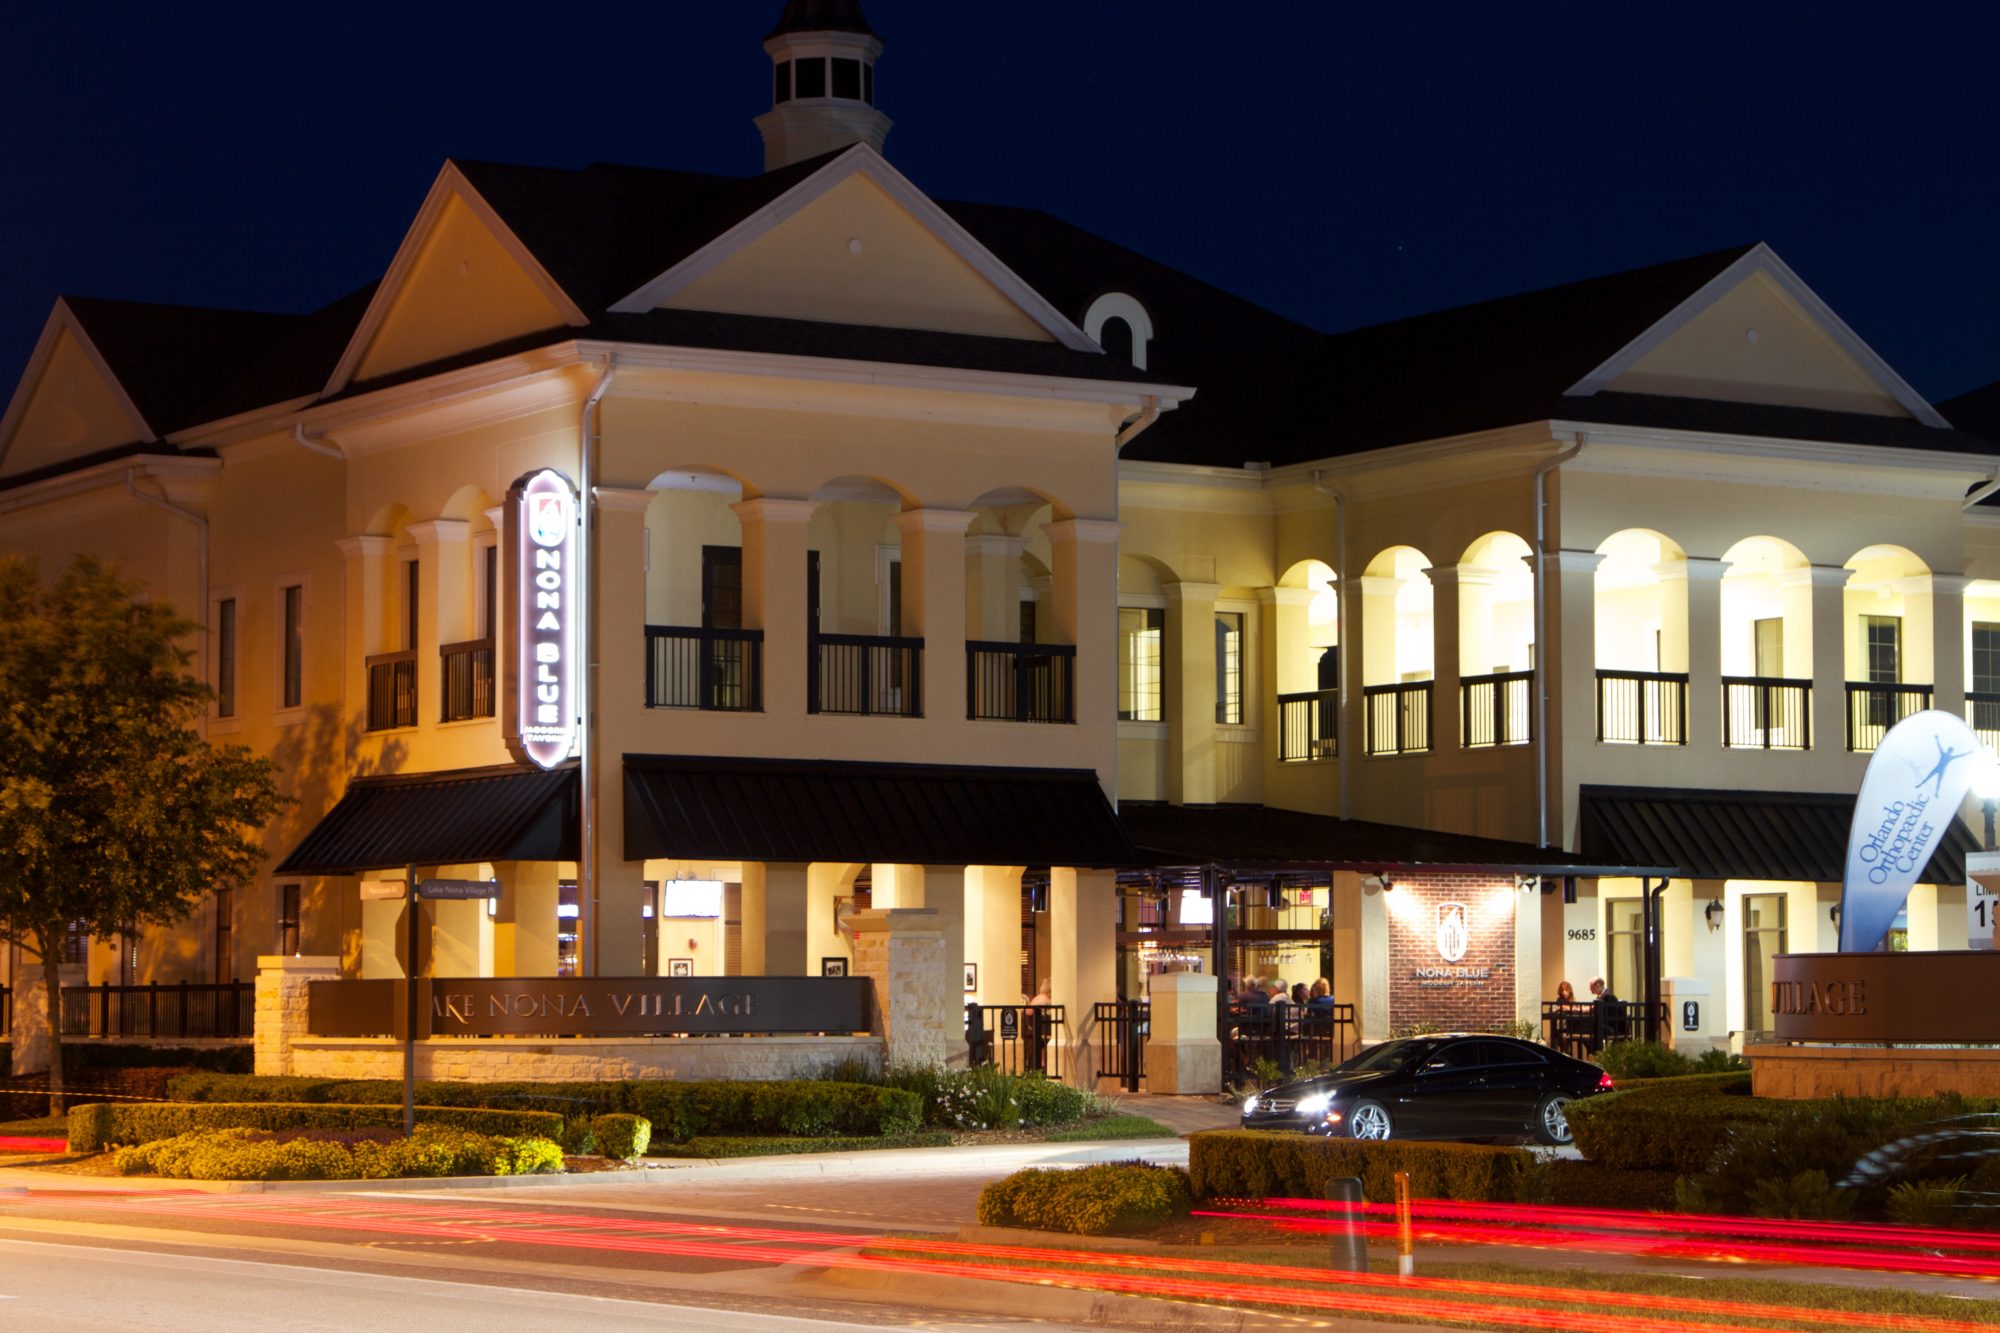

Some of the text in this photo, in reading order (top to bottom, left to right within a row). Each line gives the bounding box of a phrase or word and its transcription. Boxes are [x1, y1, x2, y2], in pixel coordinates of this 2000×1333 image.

[536, 549, 561, 723] NONA BLUE
[1860, 801, 1905, 863] Orlando
[1895, 821, 1935, 873] Center
[428, 884, 443, 893] Lake
[445, 884, 463, 893] Nona
[464, 885, 486, 895] Village
[1567, 929, 1596, 941] 9685
[1416, 967, 1489, 978] NONA BLUE
[432, 993, 759, 1024] AKE NONA VILLAGE
